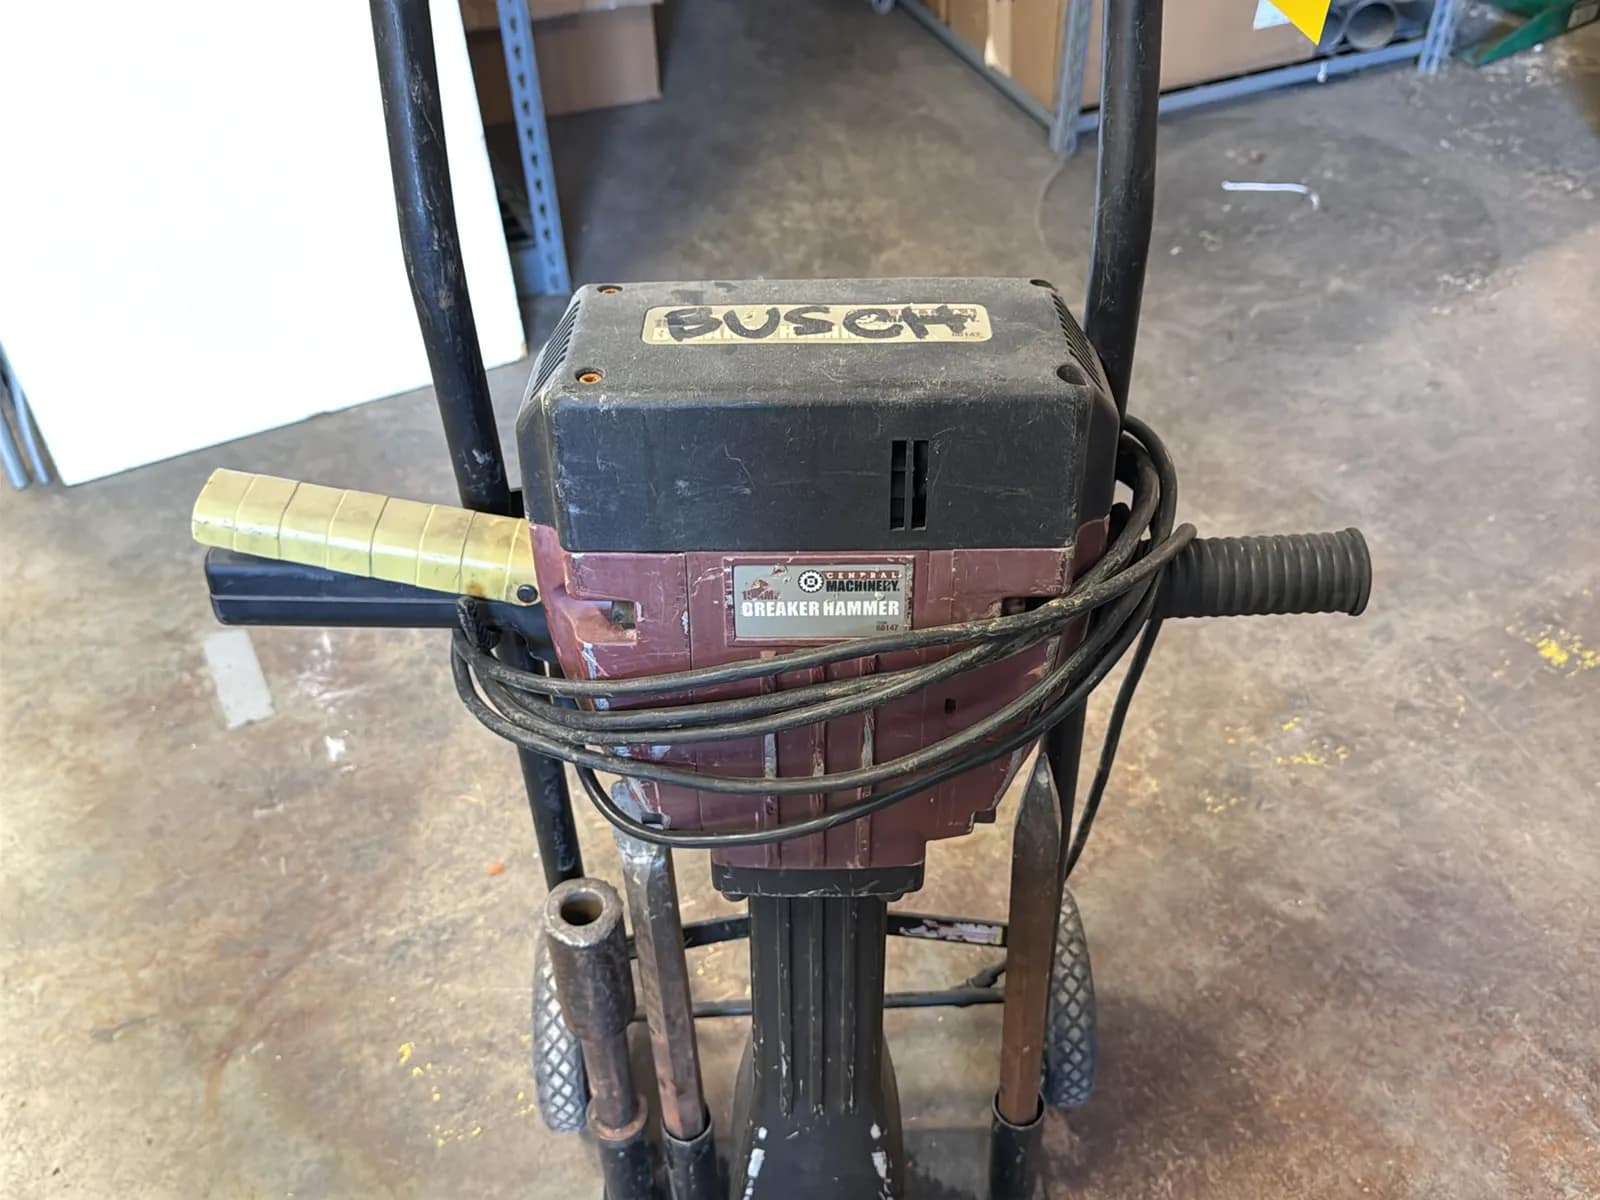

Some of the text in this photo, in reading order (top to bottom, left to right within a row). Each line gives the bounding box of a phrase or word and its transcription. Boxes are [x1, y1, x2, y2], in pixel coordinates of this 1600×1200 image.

[664, 304, 967, 341] BUSCH
[741, 600, 899, 617] BREAKER HAMMER
